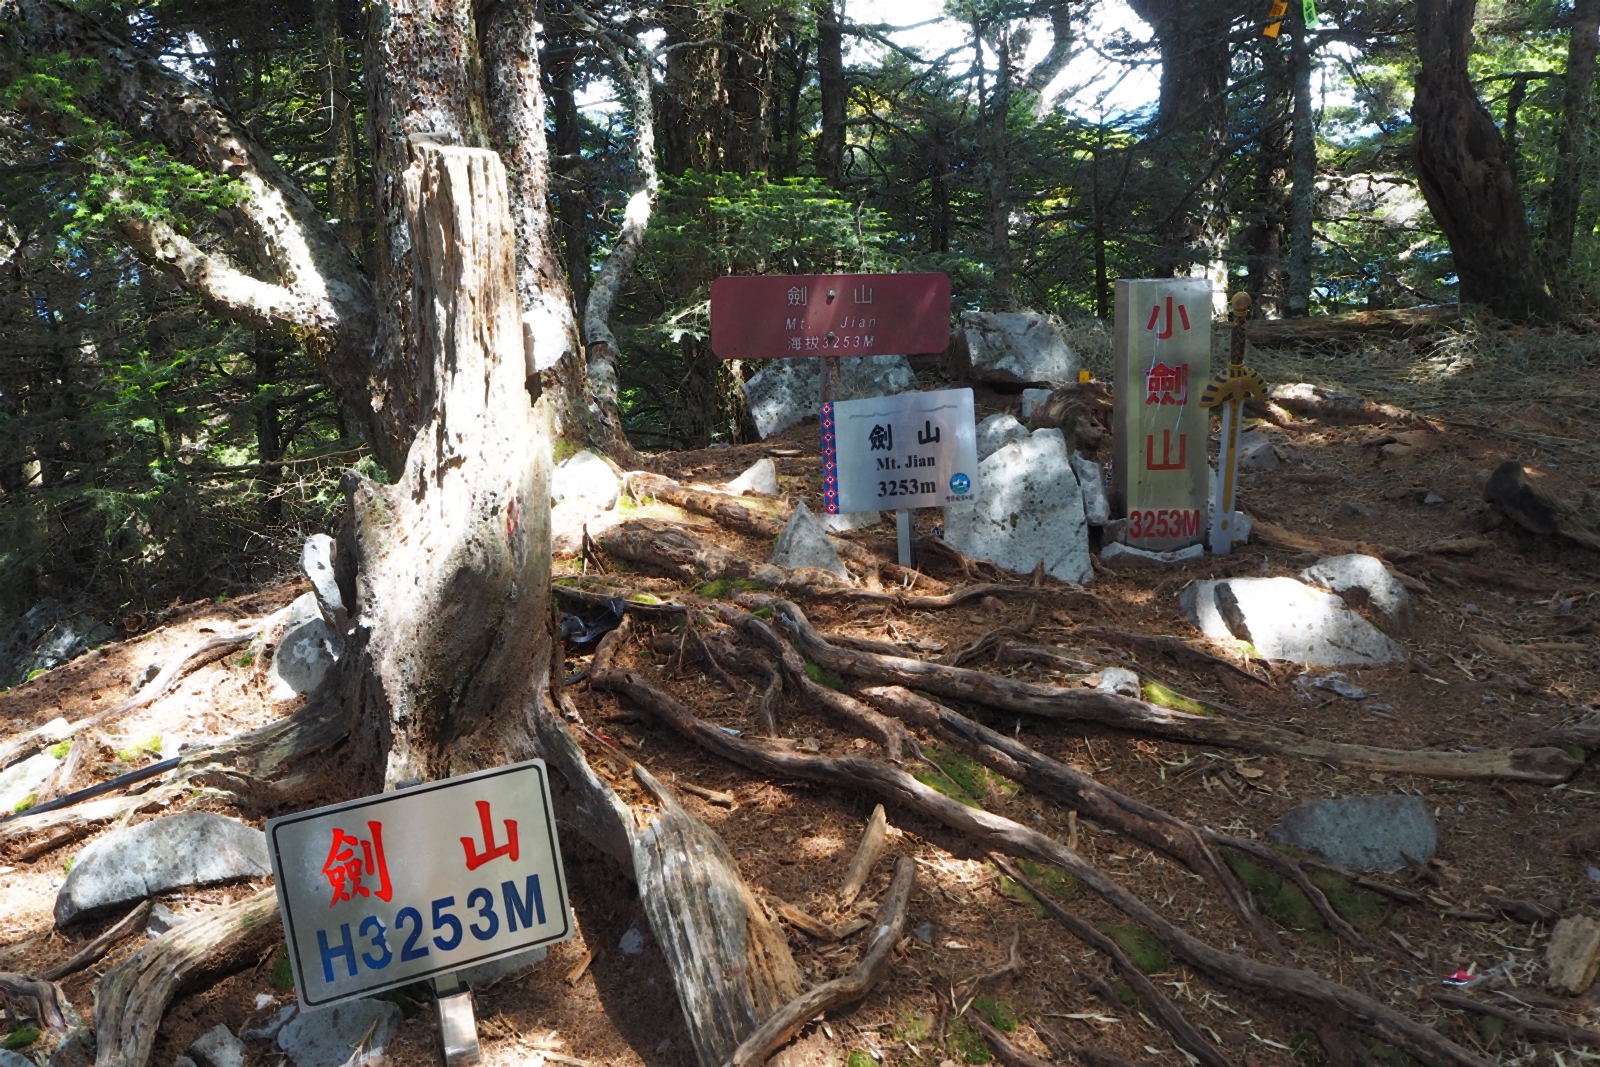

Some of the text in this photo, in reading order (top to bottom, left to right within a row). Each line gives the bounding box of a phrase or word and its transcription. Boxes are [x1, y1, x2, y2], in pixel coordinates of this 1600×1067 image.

[785, 316, 876, 330] Mt. Jian
[876, 455, 936, 471] Mt. Jian
[877, 479, 936, 497] 3253m
[1129, 509, 1201, 538] 3253M
[316, 873, 547, 983] H3253M
